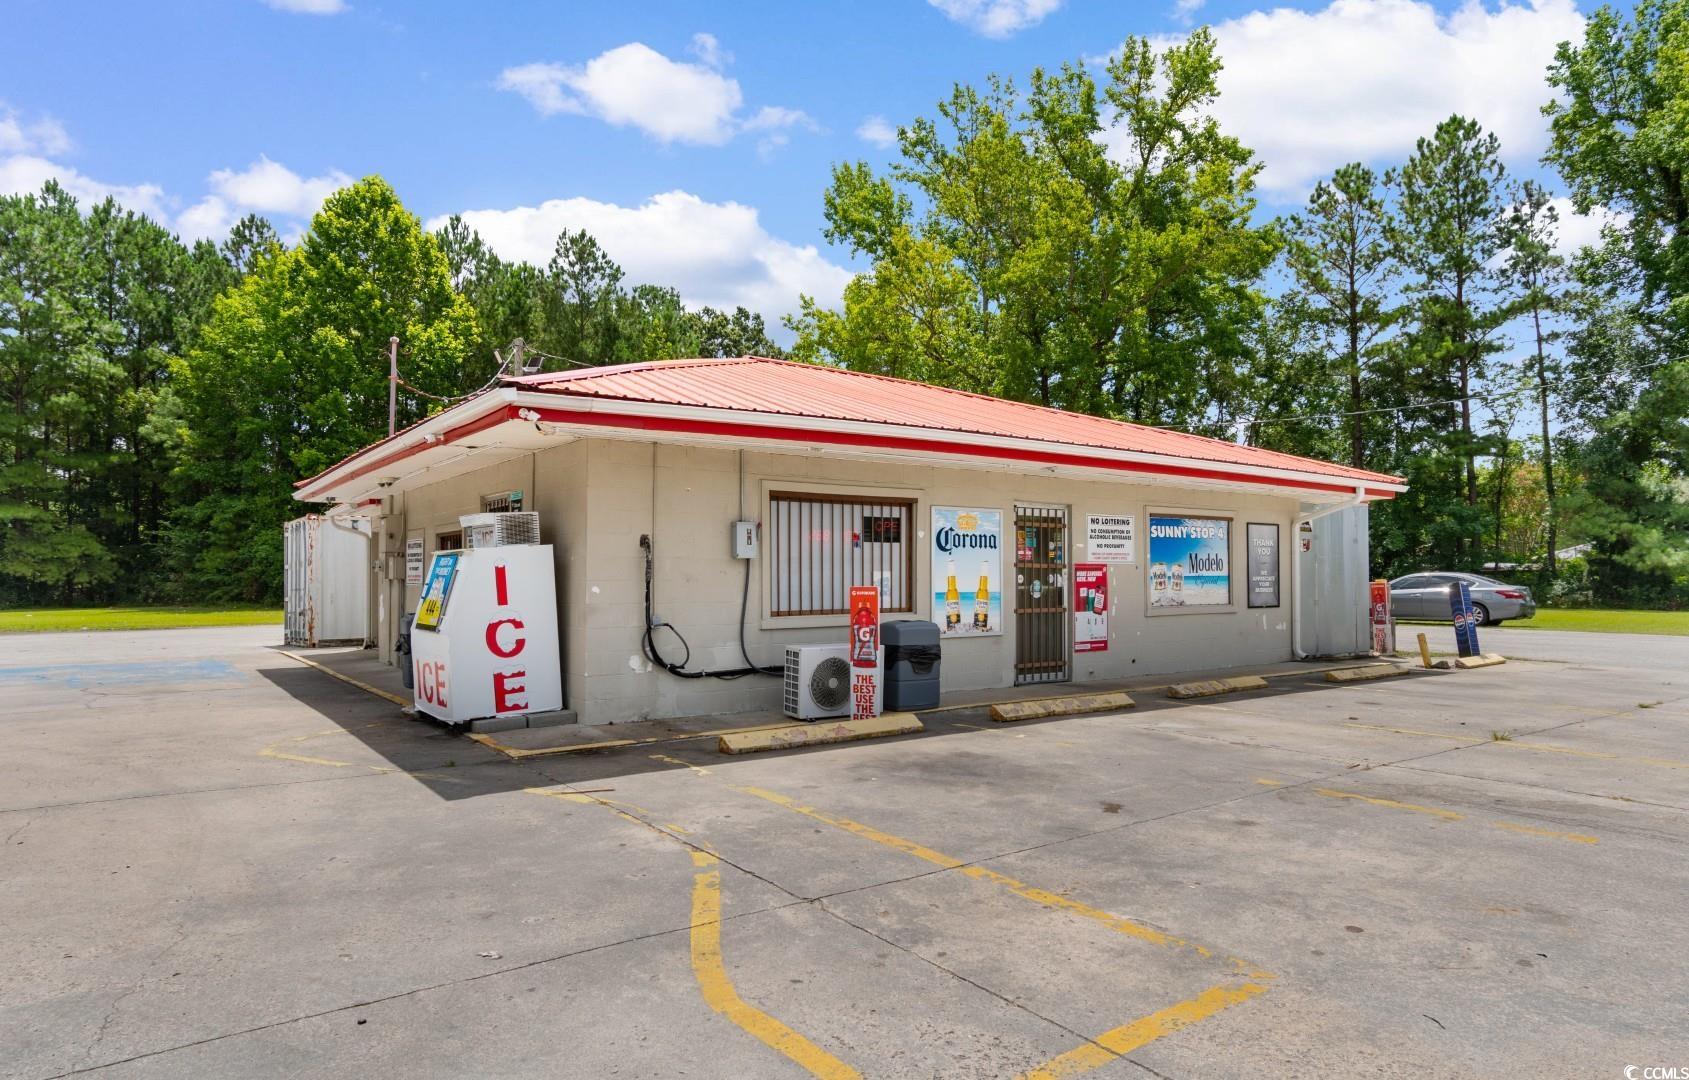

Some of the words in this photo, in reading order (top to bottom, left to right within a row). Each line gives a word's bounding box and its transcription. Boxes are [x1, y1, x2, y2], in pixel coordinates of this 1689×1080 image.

[1090, 517, 1100, 525] NO
[1101, 517, 1131, 526] LOITERING
[1151, 526, 1188, 538] SUNNY
[1191, 527, 1215, 539] STOP
[1218, 528, 1224, 539] 4
[936, 527, 997, 555] Corona
[1254, 538, 1274, 547] THANK
[1258, 548, 1271, 556] YOU
[1188, 552, 1224, 573] Modelo
[485, 566, 529, 713] ICE
[859, 627, 870, 642] G
[416, 659, 448, 709] ICE
[855, 674, 874, 685] THE
[853, 684, 877, 695] BEST
[855, 694, 874, 705] USE
[855, 703, 874, 714] THE
